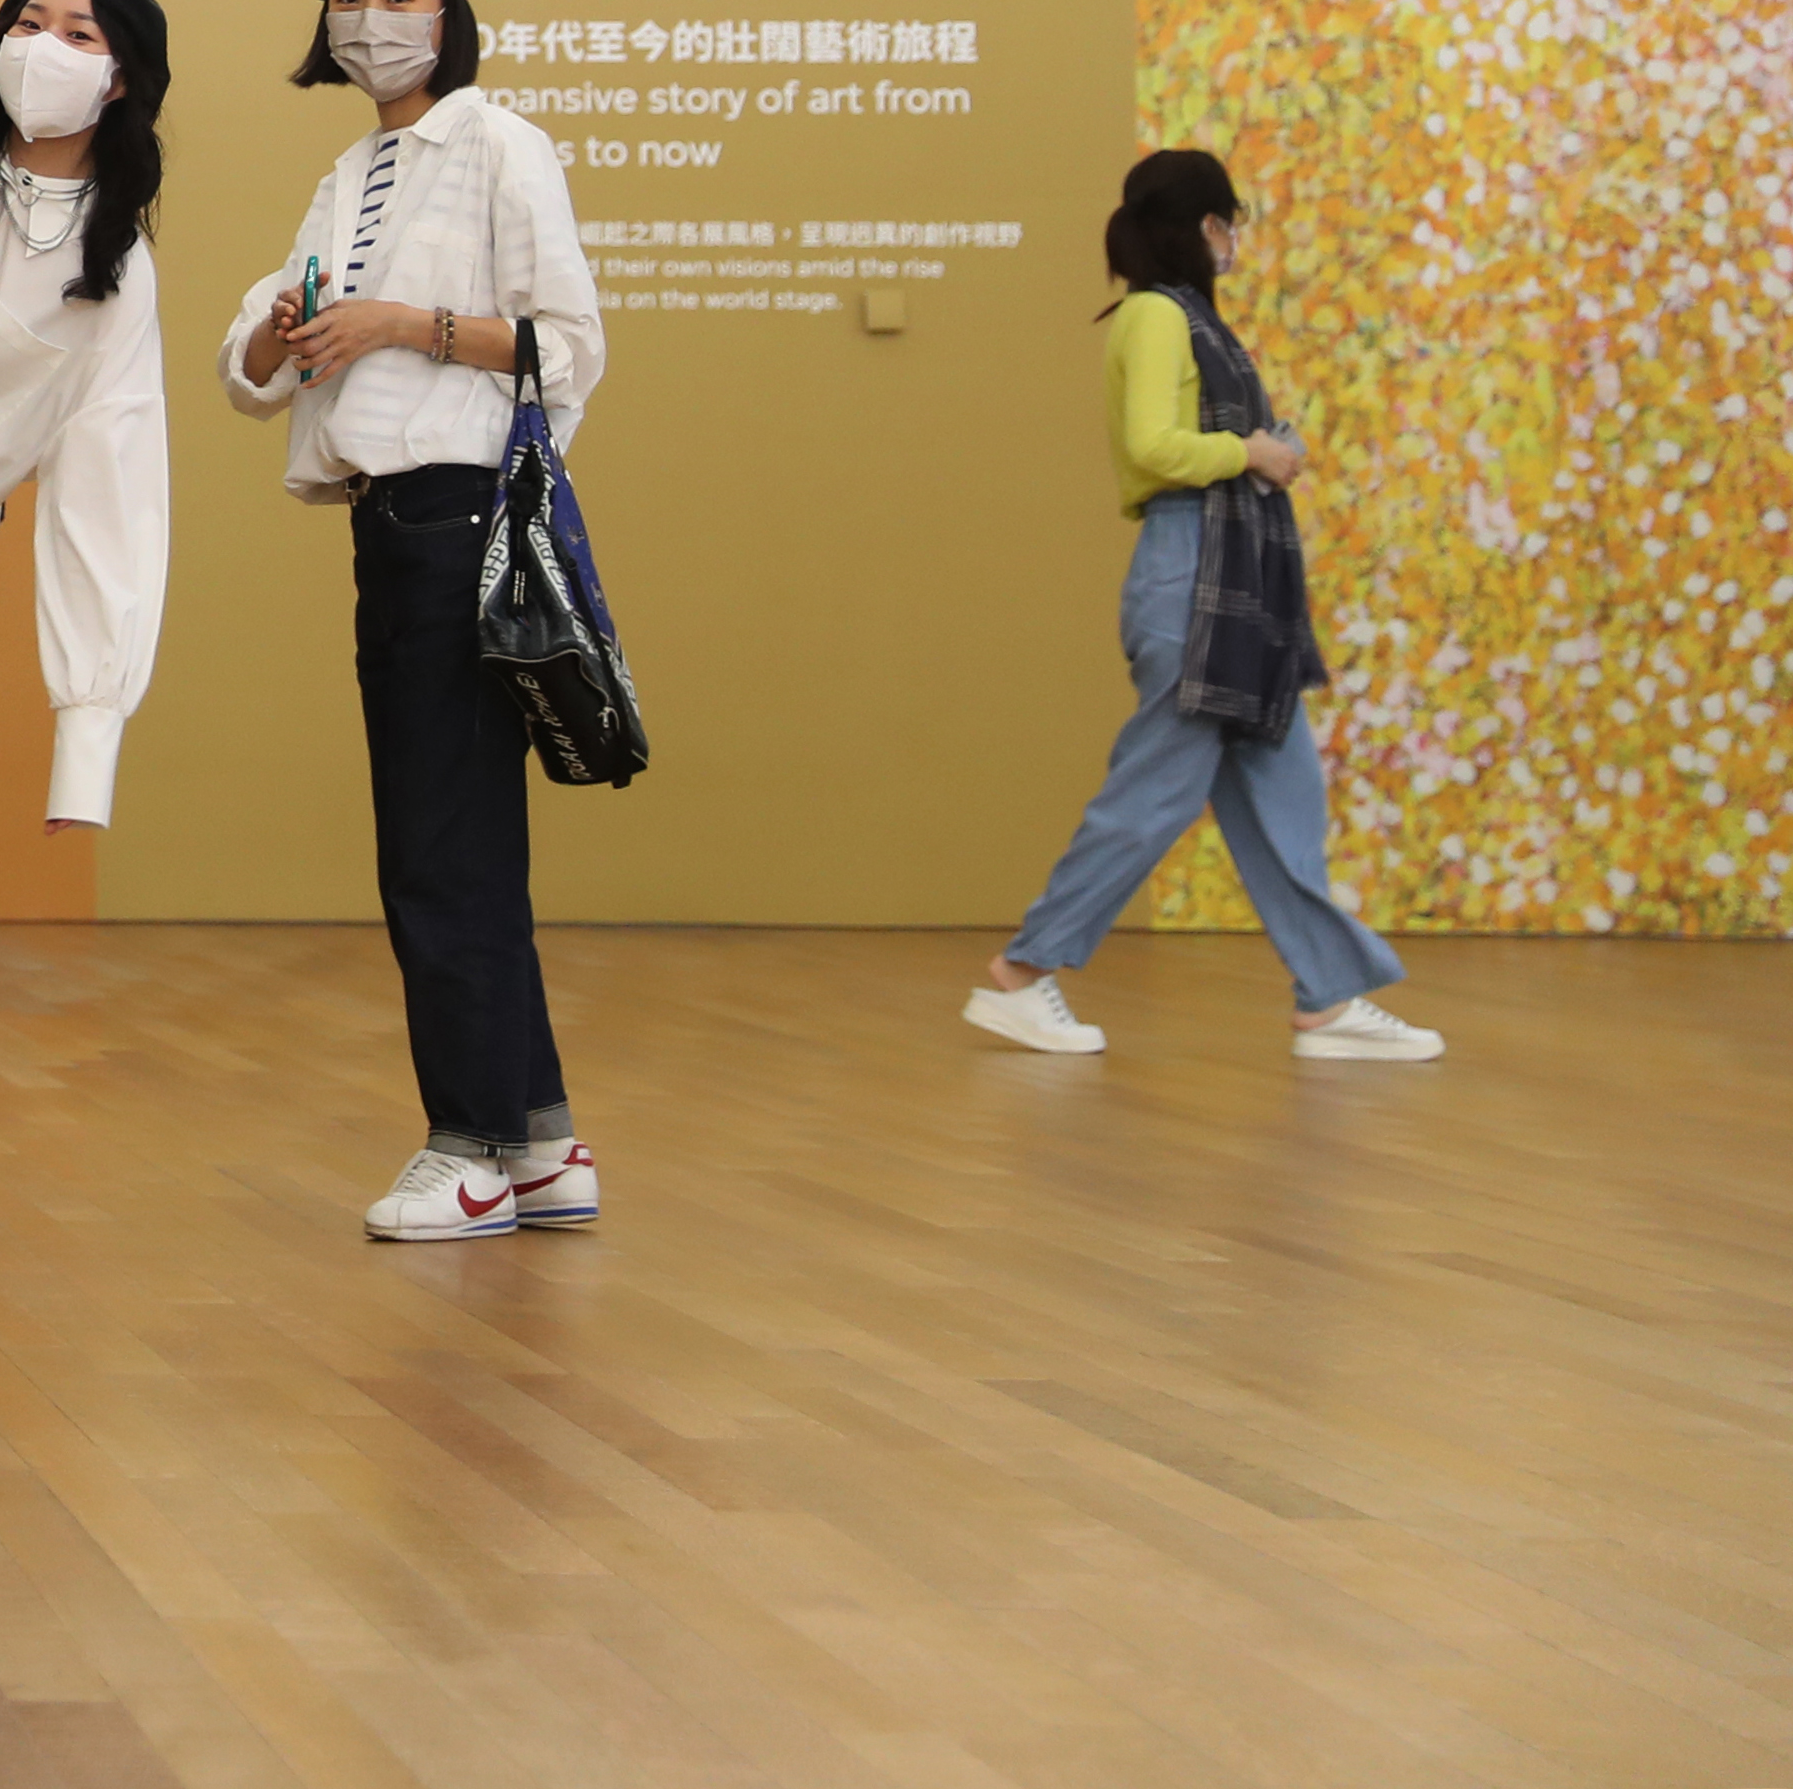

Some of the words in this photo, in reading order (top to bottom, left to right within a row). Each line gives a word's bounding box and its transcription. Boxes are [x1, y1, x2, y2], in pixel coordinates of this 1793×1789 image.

[483, 80, 639, 115] pansive
[647, 81, 748, 121] story
[756, 80, 801, 114] of
[807, 84, 864, 114] art
[873, 79, 972, 114] from
[585, 136, 629, 168] to
[638, 140, 723, 168] now
[604, 257, 659, 278] their
[661, 260, 712, 278] own
[716, 257, 793, 278] visions
[795, 257, 855, 278] amid
[859, 257, 899, 278] the
[901, 257, 946, 278] rise
[625, 292, 657, 310] on
[660, 288, 701, 310] the
[704, 288, 770, 310] world
[774, 291, 844, 314] stage.
